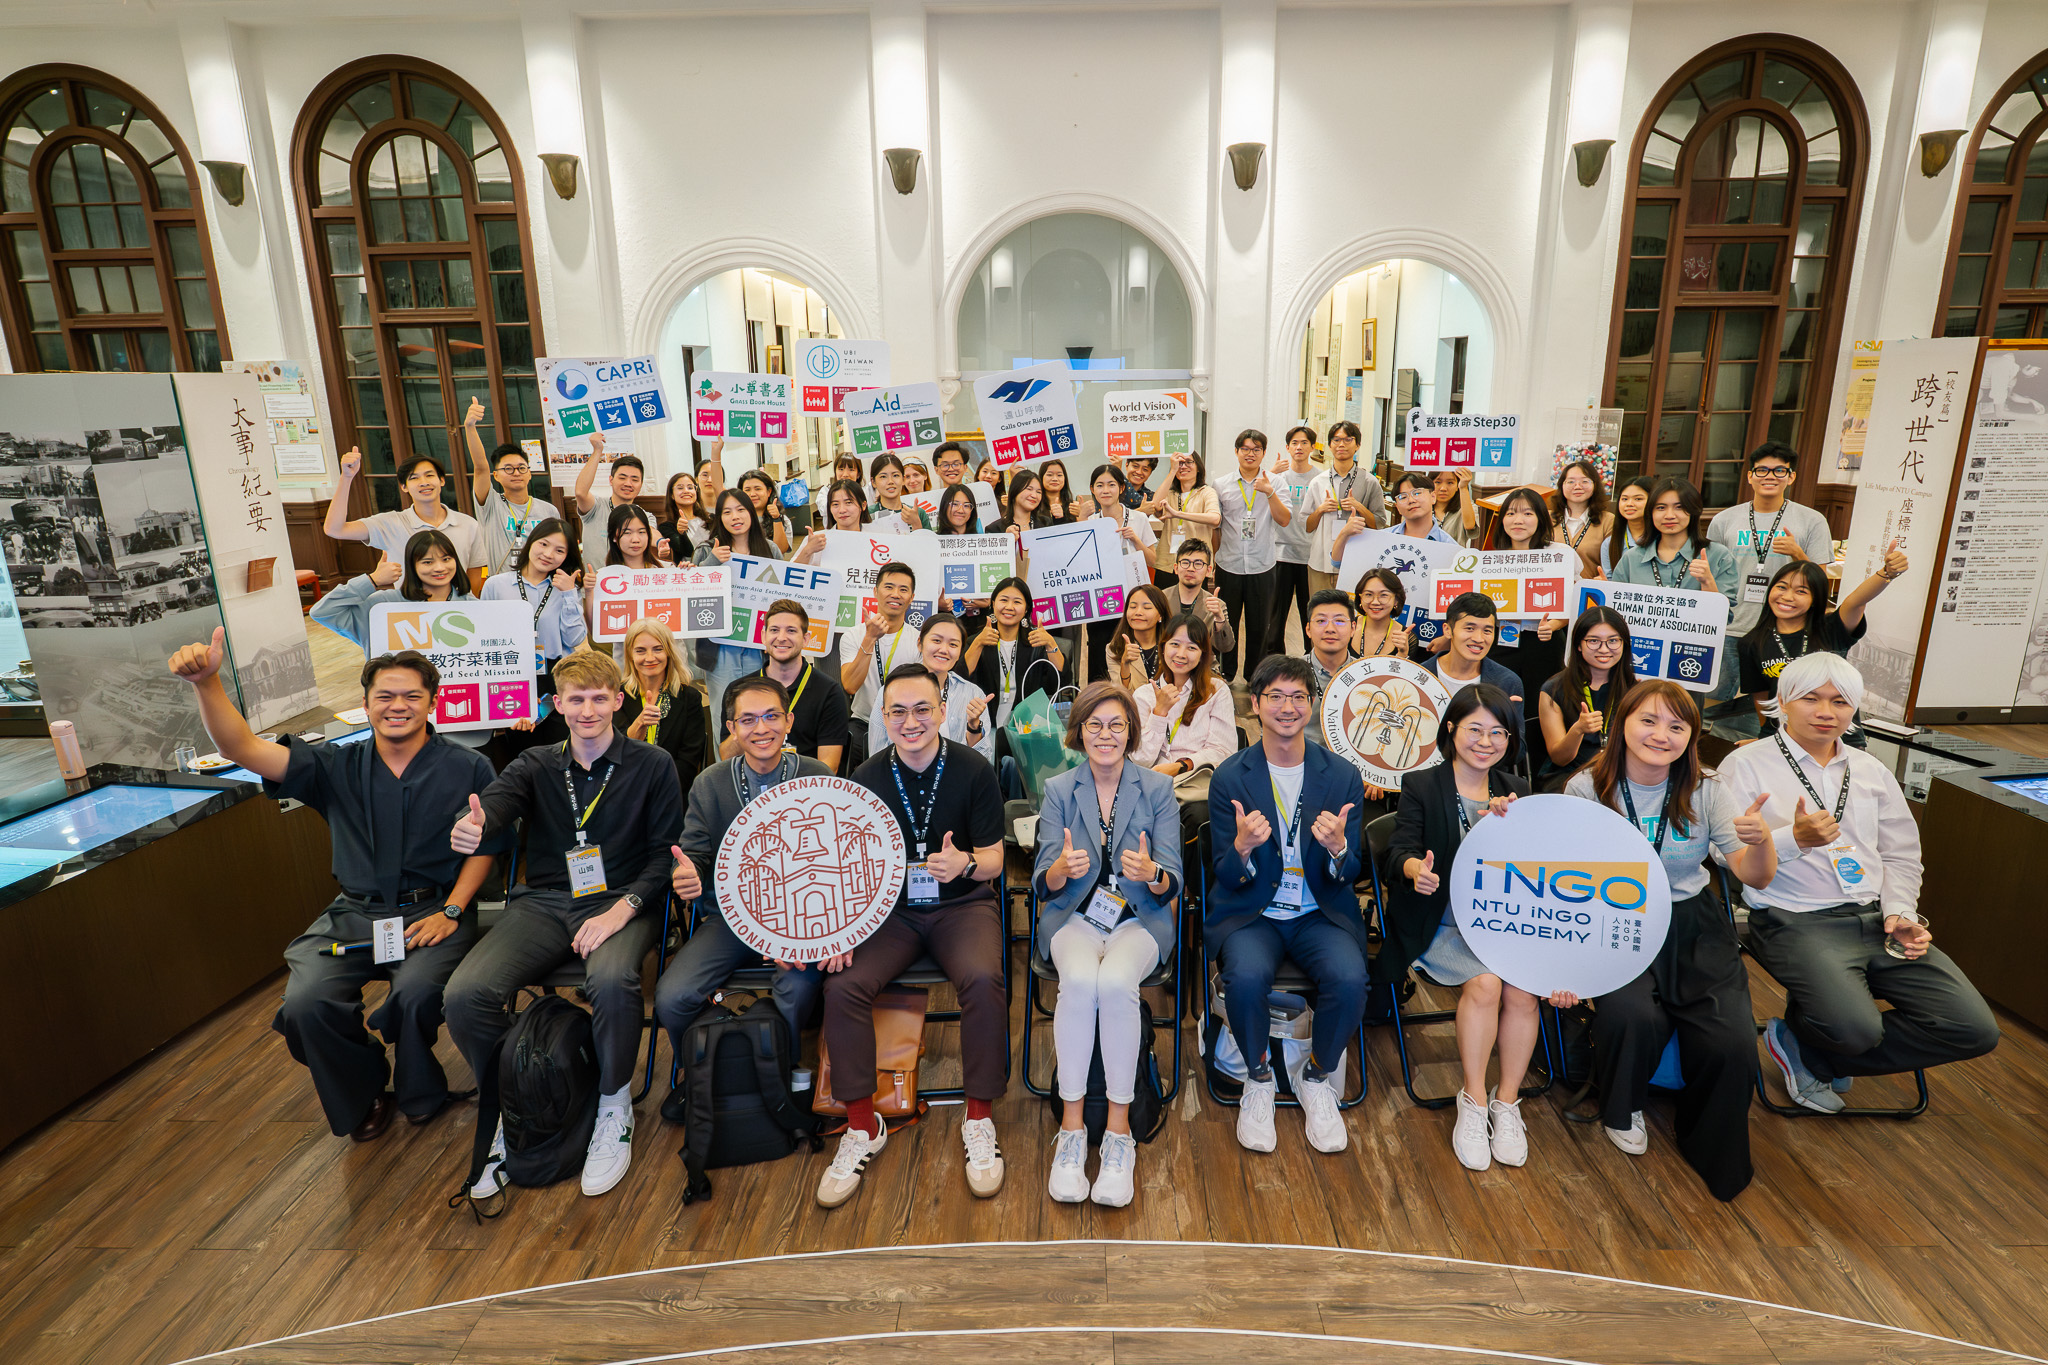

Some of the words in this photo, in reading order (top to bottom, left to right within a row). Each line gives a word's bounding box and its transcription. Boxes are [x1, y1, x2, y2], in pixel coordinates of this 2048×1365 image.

[730, 380, 786, 398] 小草書屋
[872, 392, 900, 414] Aid
[1109, 402, 1141, 412] World
[1144, 401, 1176, 411] Vision
[1032, 416, 1053, 424] Ridges
[1426, 416, 1472, 428] 舊鞋救命
[1474, 416, 1516, 429] Step30
[1898, 373, 1942, 484] 跨世代
[228, 466, 260, 475] Chronology
[231, 398, 272, 532] 大事紀要
[1911, 488, 1932, 498] Campus
[1895, 498, 1914, 549] 座標記
[1482, 553, 1564, 565] 台灣好鄰居協會
[632, 571, 723, 586] 勵馨基金會
[1042, 569, 1067, 579] LEAD
[1504, 566, 1544, 575] Neighbors
[1044, 579, 1062, 588] FOR
[1066, 572, 1103, 585] TAIWAN
[731, 584, 762, 592] aiwan-Asia
[765, 589, 792, 597] Exchange
[794, 593, 826, 602] Foundation
[1613, 591, 1698, 608] 台灣數位外交協會
[1612, 602, 1643, 614] TAIWAN
[1648, 606, 1680, 618] DIGITAL
[1660, 620, 1717, 635] ASSOCIATION
[481, 638, 515, 647] 財團法人
[1674, 645, 1682, 654] 17
[425, 650, 520, 668] 教芥菜種會
[458, 669, 480, 678] Seed
[484, 668, 521, 676] Mission
[490, 685, 499, 694] 10
[1340, 661, 1448, 706] 國立臺灣大
[439, 688, 445, 697] 4
[1328, 708, 1348, 755] National
[1350, 756, 1387, 785] Taiwan
[718, 826, 740, 882] OFFICE
[737, 808, 753, 825] OF
[756, 778, 867, 808] INTERNATIONAL
[869, 799, 904, 851] AFFAIRS
[1474, 858, 1647, 910] iNGO
[720, 894, 771, 954] NATIONAL
[780, 942, 842, 960] TAIWAN
[847, 864, 904, 946] UNIVERSITY
[1472, 898, 1520, 916] NTU
[1531, 906, 1591, 925] iNGO
[1471, 917, 1591, 943] ACADEMY
[1611, 917, 1620, 950] 人才學校
[1632, 919, 1642, 953] 臺大國際
